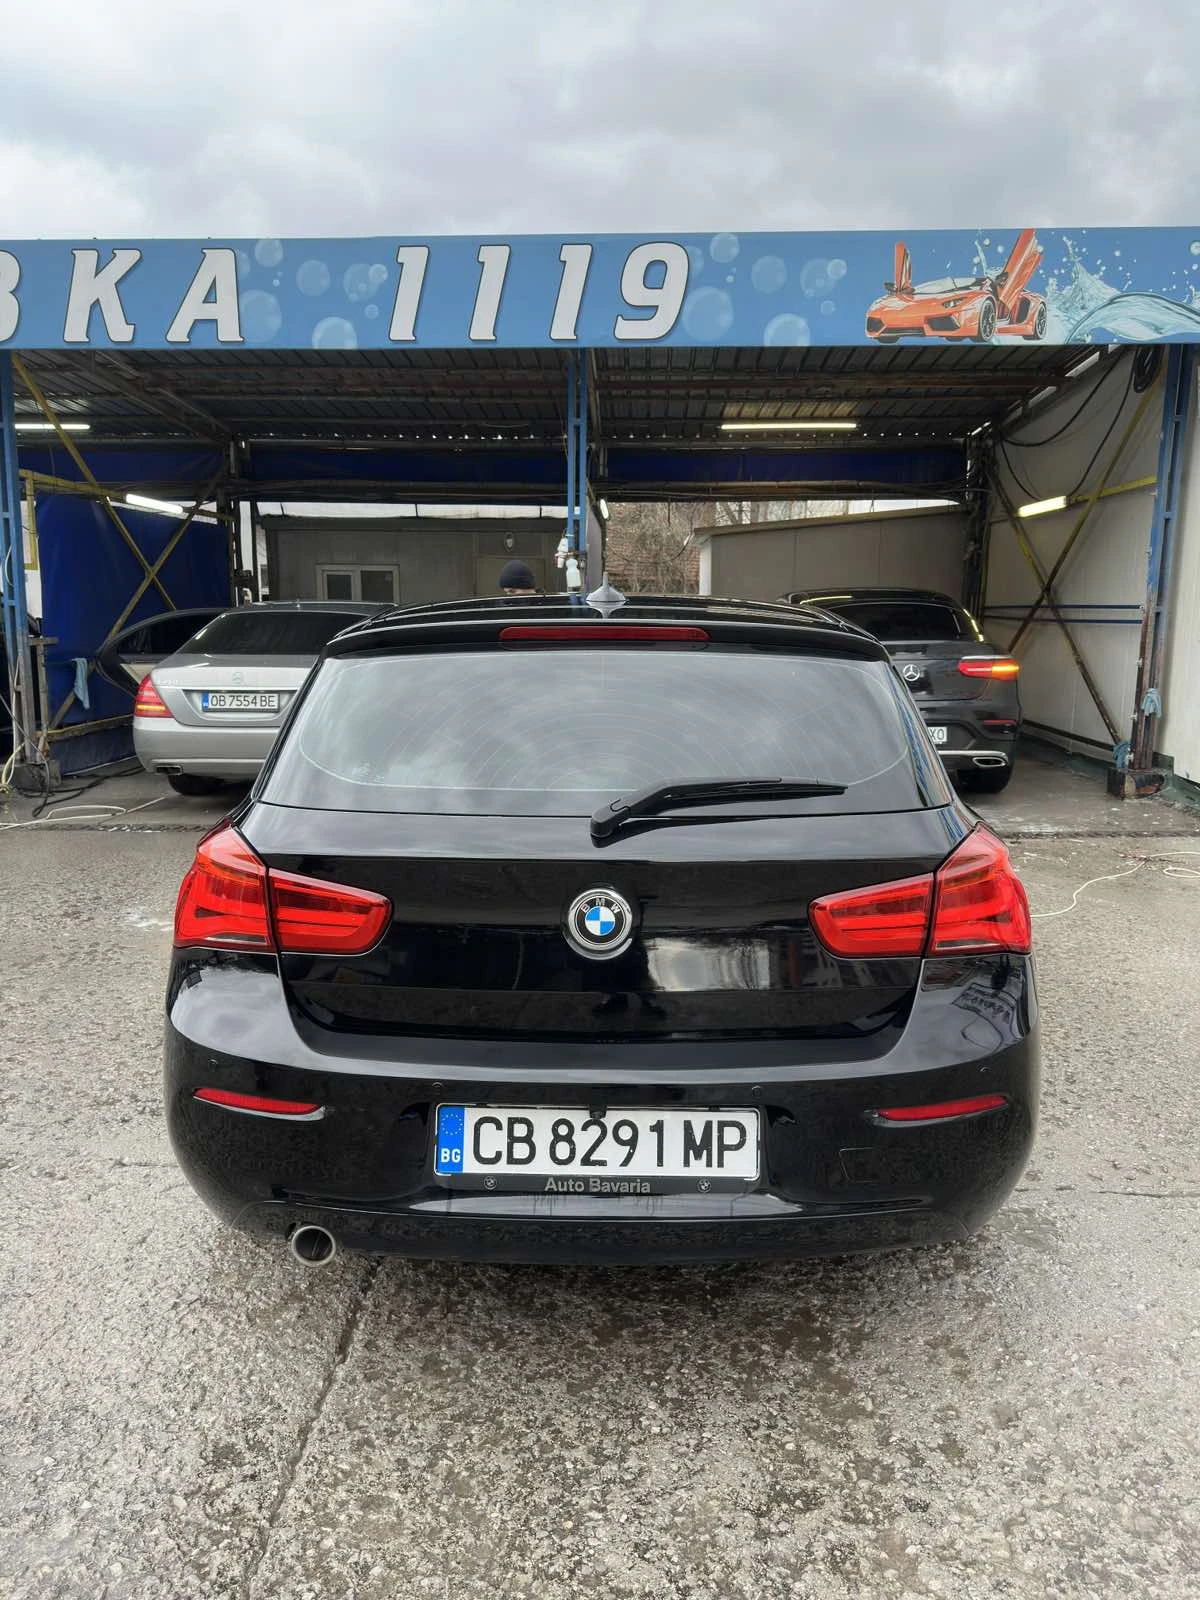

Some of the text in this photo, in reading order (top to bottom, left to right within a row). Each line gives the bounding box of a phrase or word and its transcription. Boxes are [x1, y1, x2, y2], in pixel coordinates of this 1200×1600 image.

[389, 241, 690, 342] 1119
[211, 695, 226, 707] OB
[228, 695, 258, 707] 7554
[260, 695, 276, 707] BE
[580, 897, 621, 914] BMW
[472, 1116, 747, 1169] CB 8291 MP
[440, 1148, 461, 1163] BG
[544, 1177, 651, 1193] Auto Bavaria
